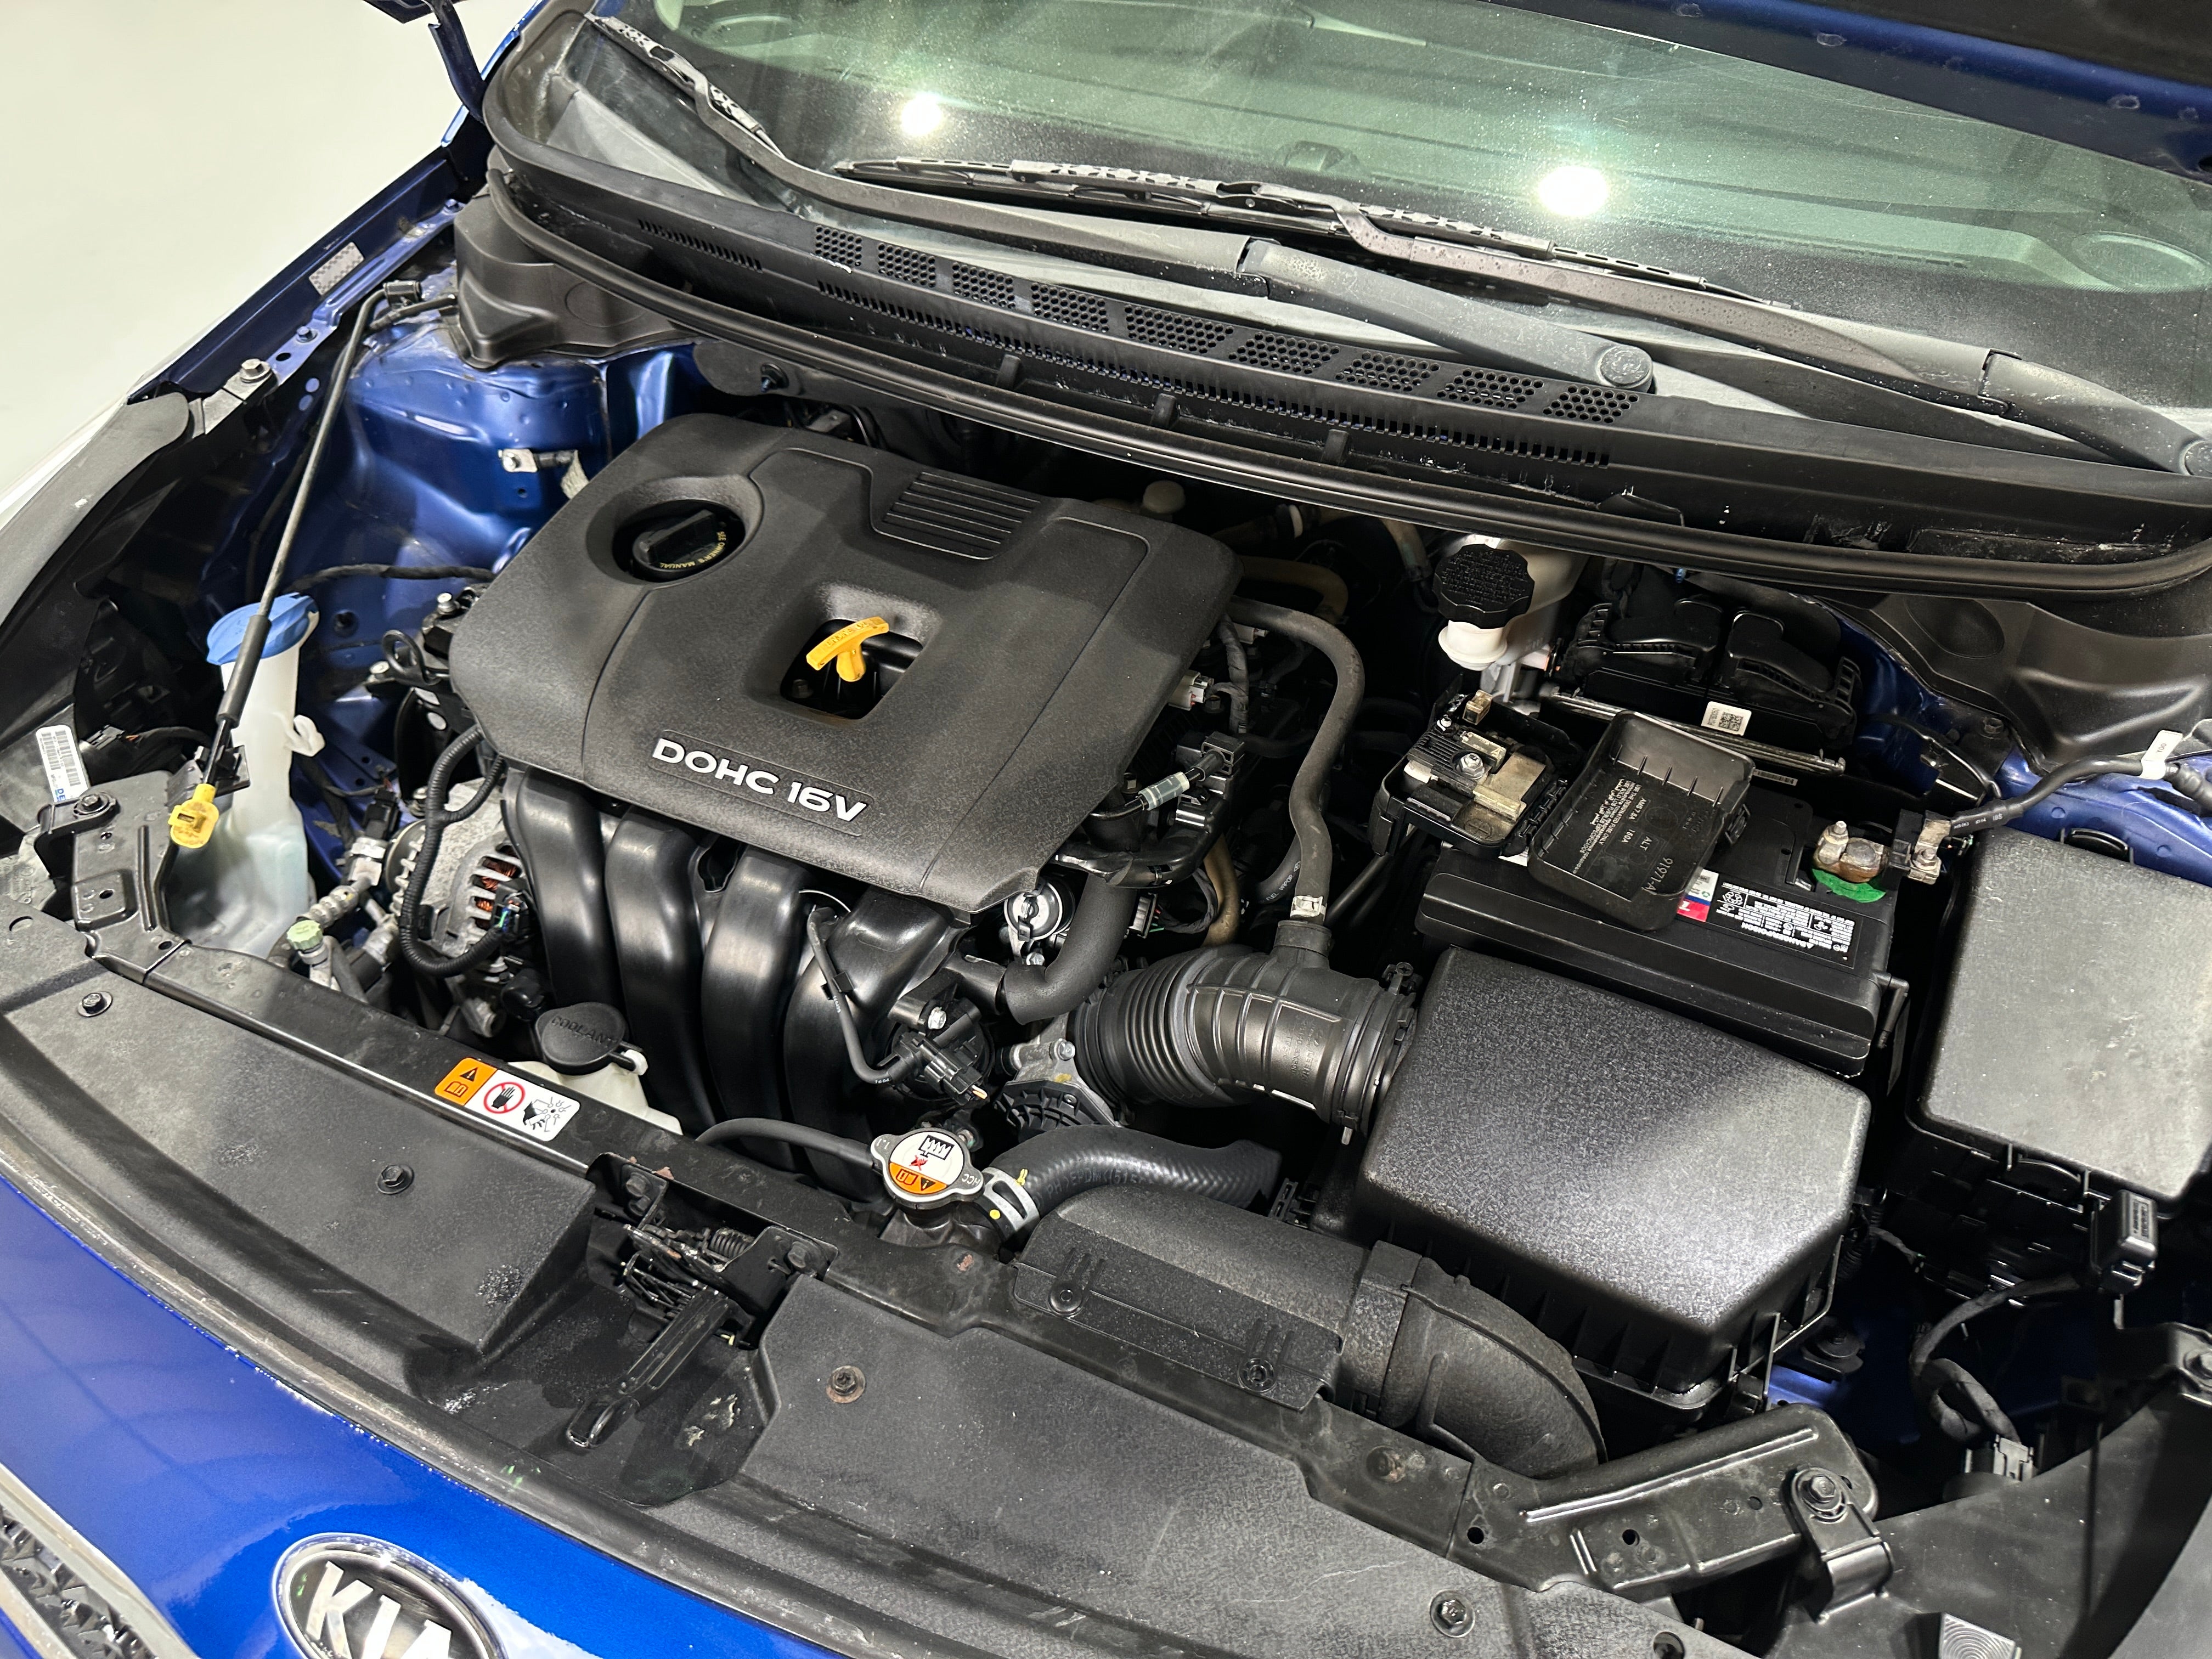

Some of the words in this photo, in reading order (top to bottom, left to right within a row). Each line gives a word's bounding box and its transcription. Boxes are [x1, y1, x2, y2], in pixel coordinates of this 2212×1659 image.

[717, 531, 726, 541] SEE
[698, 542, 725, 563] OWNER'S
[660, 560, 696, 569] MANUAL
[826, 628, 854, 647] ENGINE
[652, 738, 780, 794] DOHC
[787, 782, 867, 821] 16V
[57, 788, 66, 802] DE
[1616, 787, 1627, 799] SOLO
[1633, 784, 1643, 793] USE
[1610, 798, 1620, 807] LOS
[1628, 792, 1638, 800] THE
[1635, 796, 1647, 809] AMS
[1600, 806, 1615, 824] FUSIBLES
[1612, 799, 1632, 823] DESIGNATED
[1628, 808, 1641, 821] 7.5A
[1605, 823, 1616, 834] FUSE
[1579, 823, 1603, 854] ESPECIFICADOS
[1599, 833, 1610, 845] ONLY
[1621, 829, 1636, 843] 150A
[1640, 836, 1653, 851] ALT
[1645, 857, 1673, 890] 91971-A
[1266, 893, 1279, 901] FUEL
[1278, 874, 1294, 890] VAPOR
[961, 1173, 981, 1187] HCC
[306, 1560, 453, 1659] KIA
